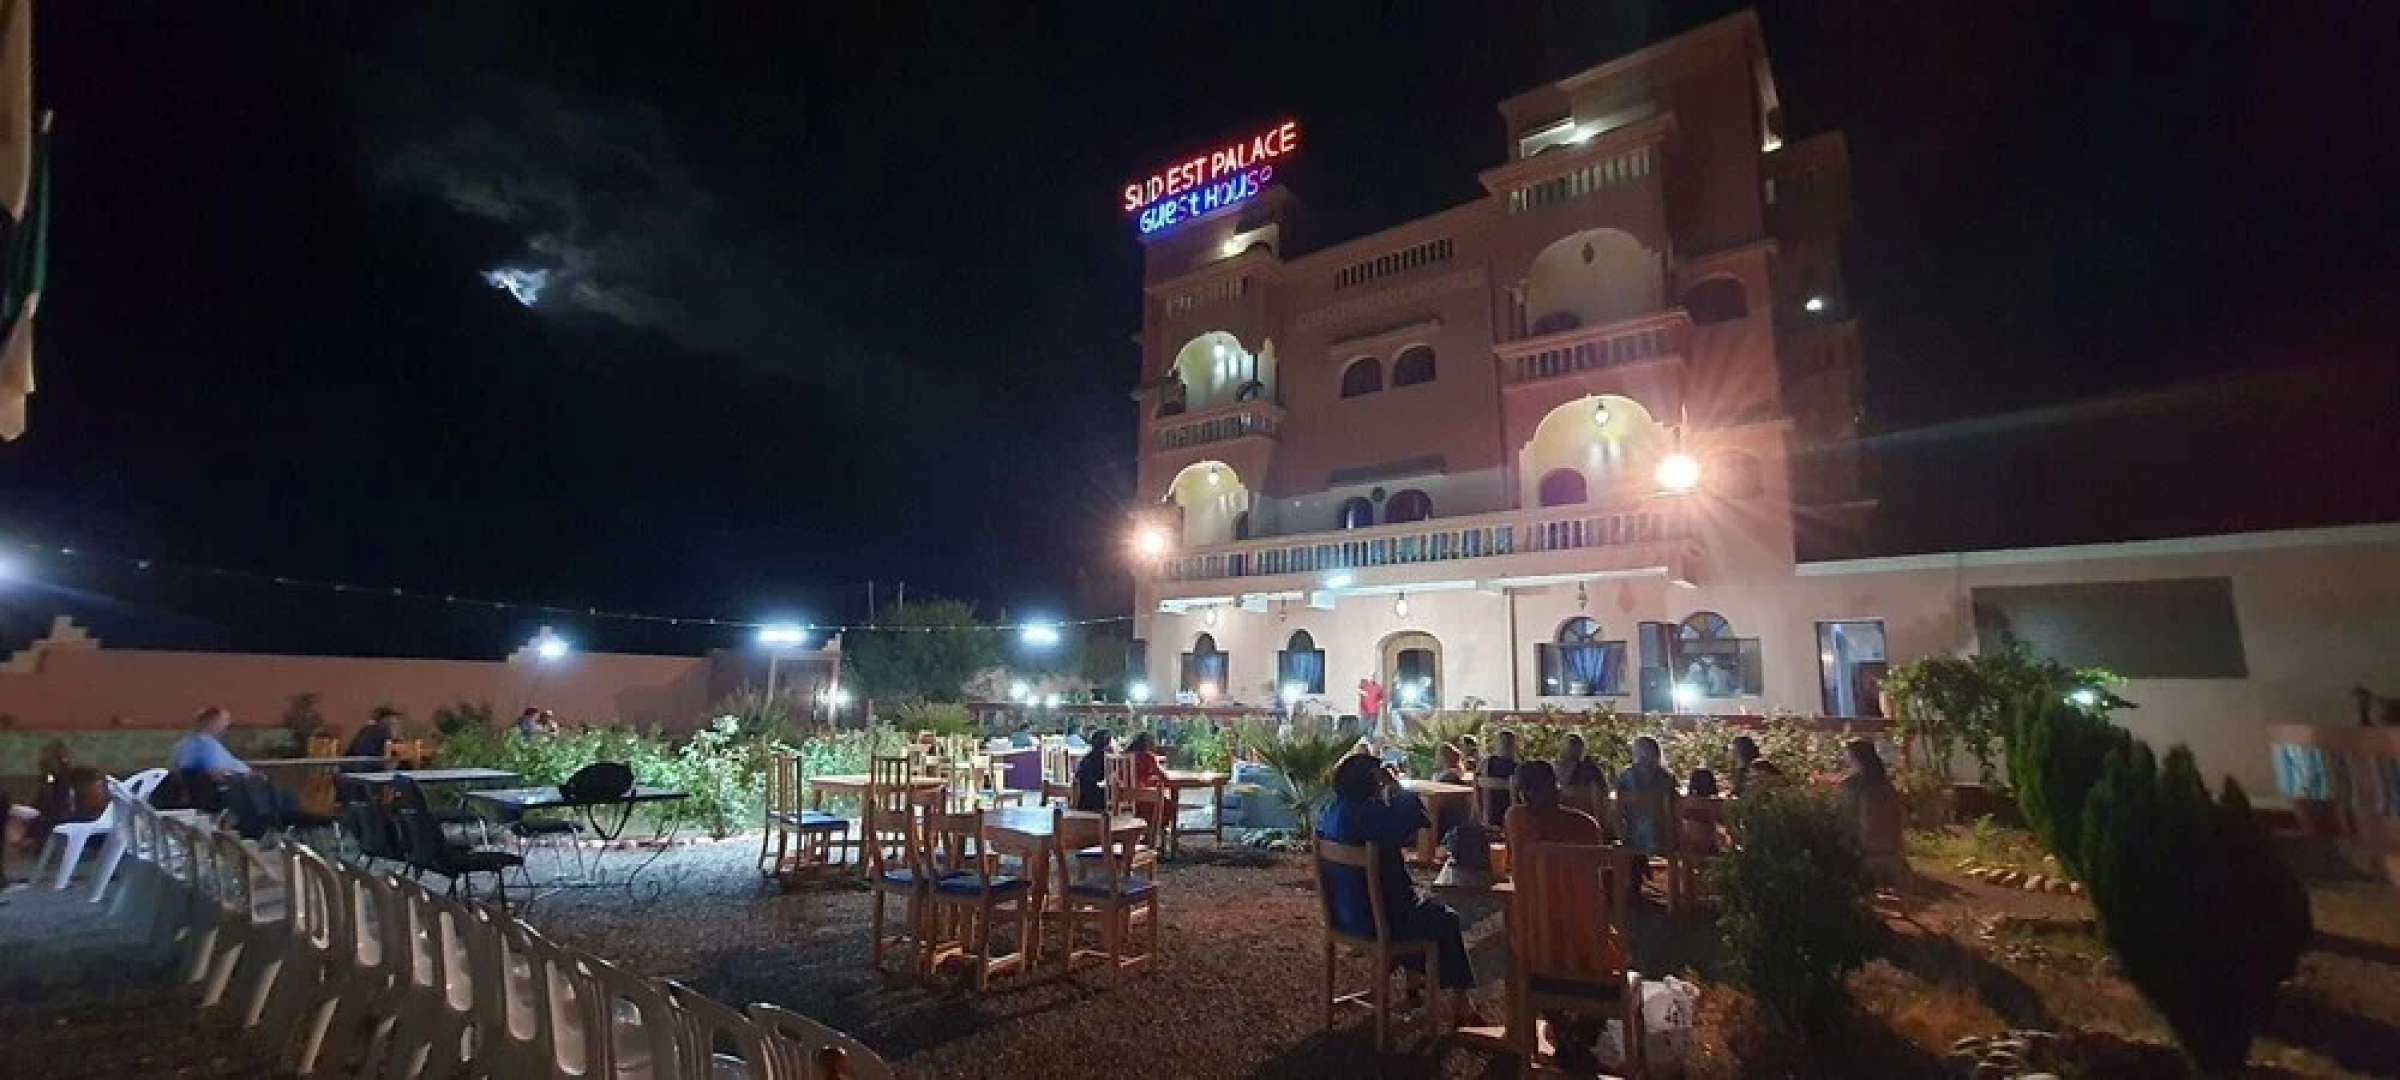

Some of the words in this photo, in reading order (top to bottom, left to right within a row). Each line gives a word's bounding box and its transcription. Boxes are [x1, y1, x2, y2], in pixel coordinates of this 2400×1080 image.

[1125, 175, 1165, 212] SUD
[1168, 156, 1208, 195] EST
[1211, 121, 1296, 178] PALACE
